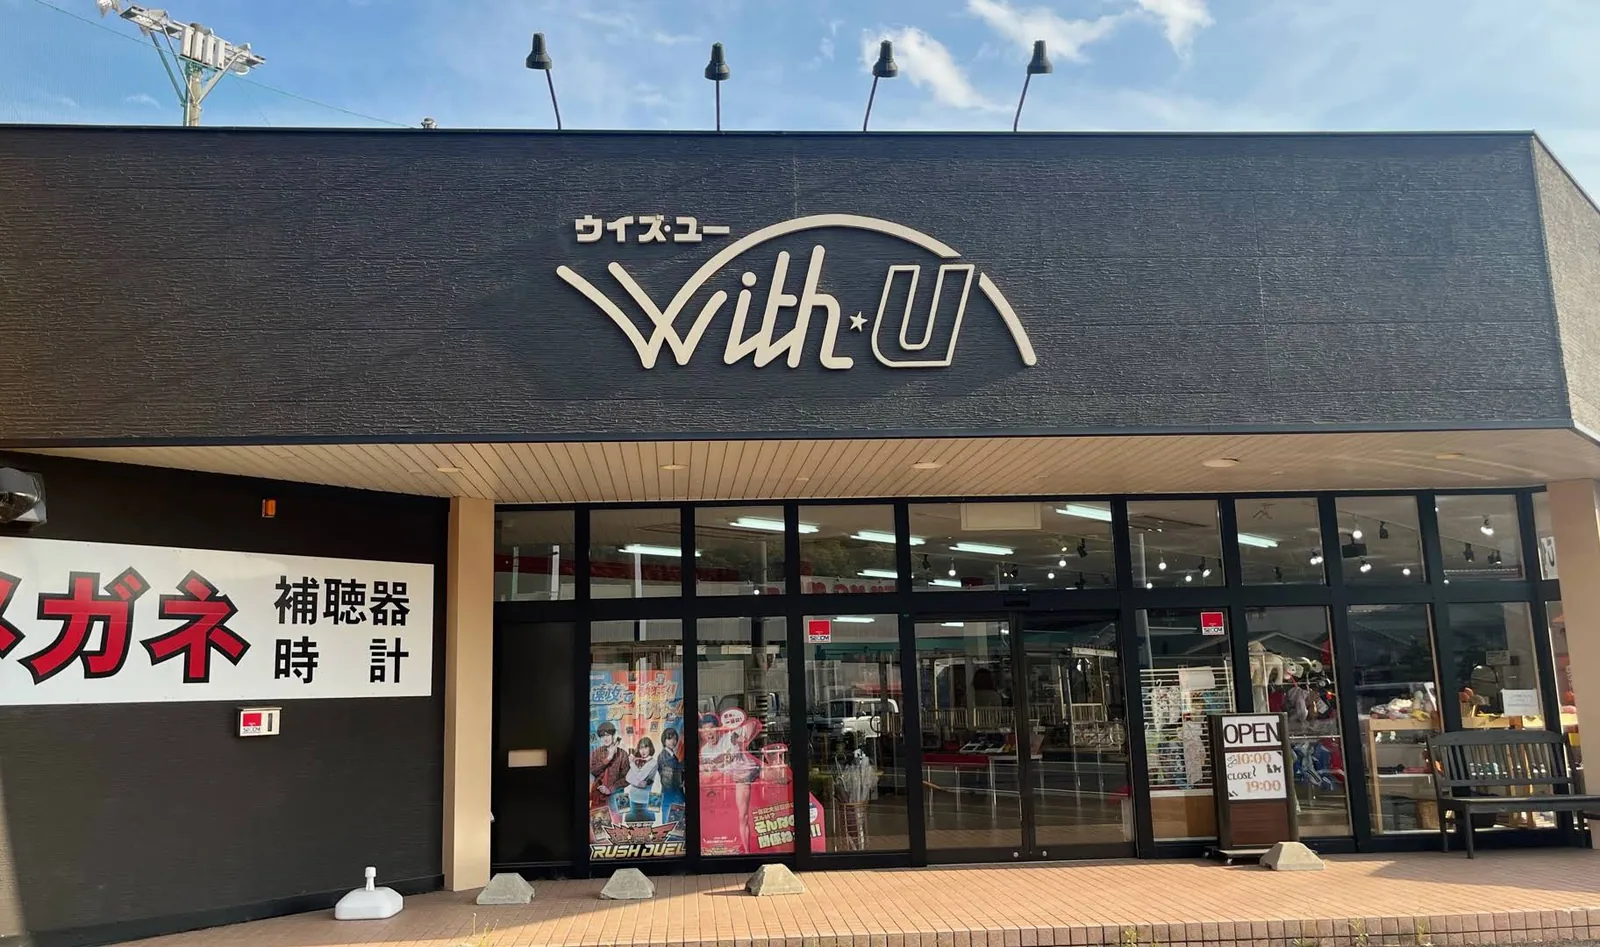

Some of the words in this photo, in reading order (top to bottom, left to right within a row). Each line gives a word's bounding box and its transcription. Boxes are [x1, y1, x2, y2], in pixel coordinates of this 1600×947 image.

[556, 244, 855, 369] With
[871, 264, 975, 368] U
[274, 576, 410, 626] 補聴器
[0, 566, 251, 685] ガネ
[1223, 722, 1281, 744] OPEN
[1236, 752, 1272, 765] 10:00
[1227, 772, 1253, 781] CLOSE
[1245, 780, 1281, 793] 19:00
[593, 844, 641, 859] RUSH
[641, 842, 687, 857] DUEL
